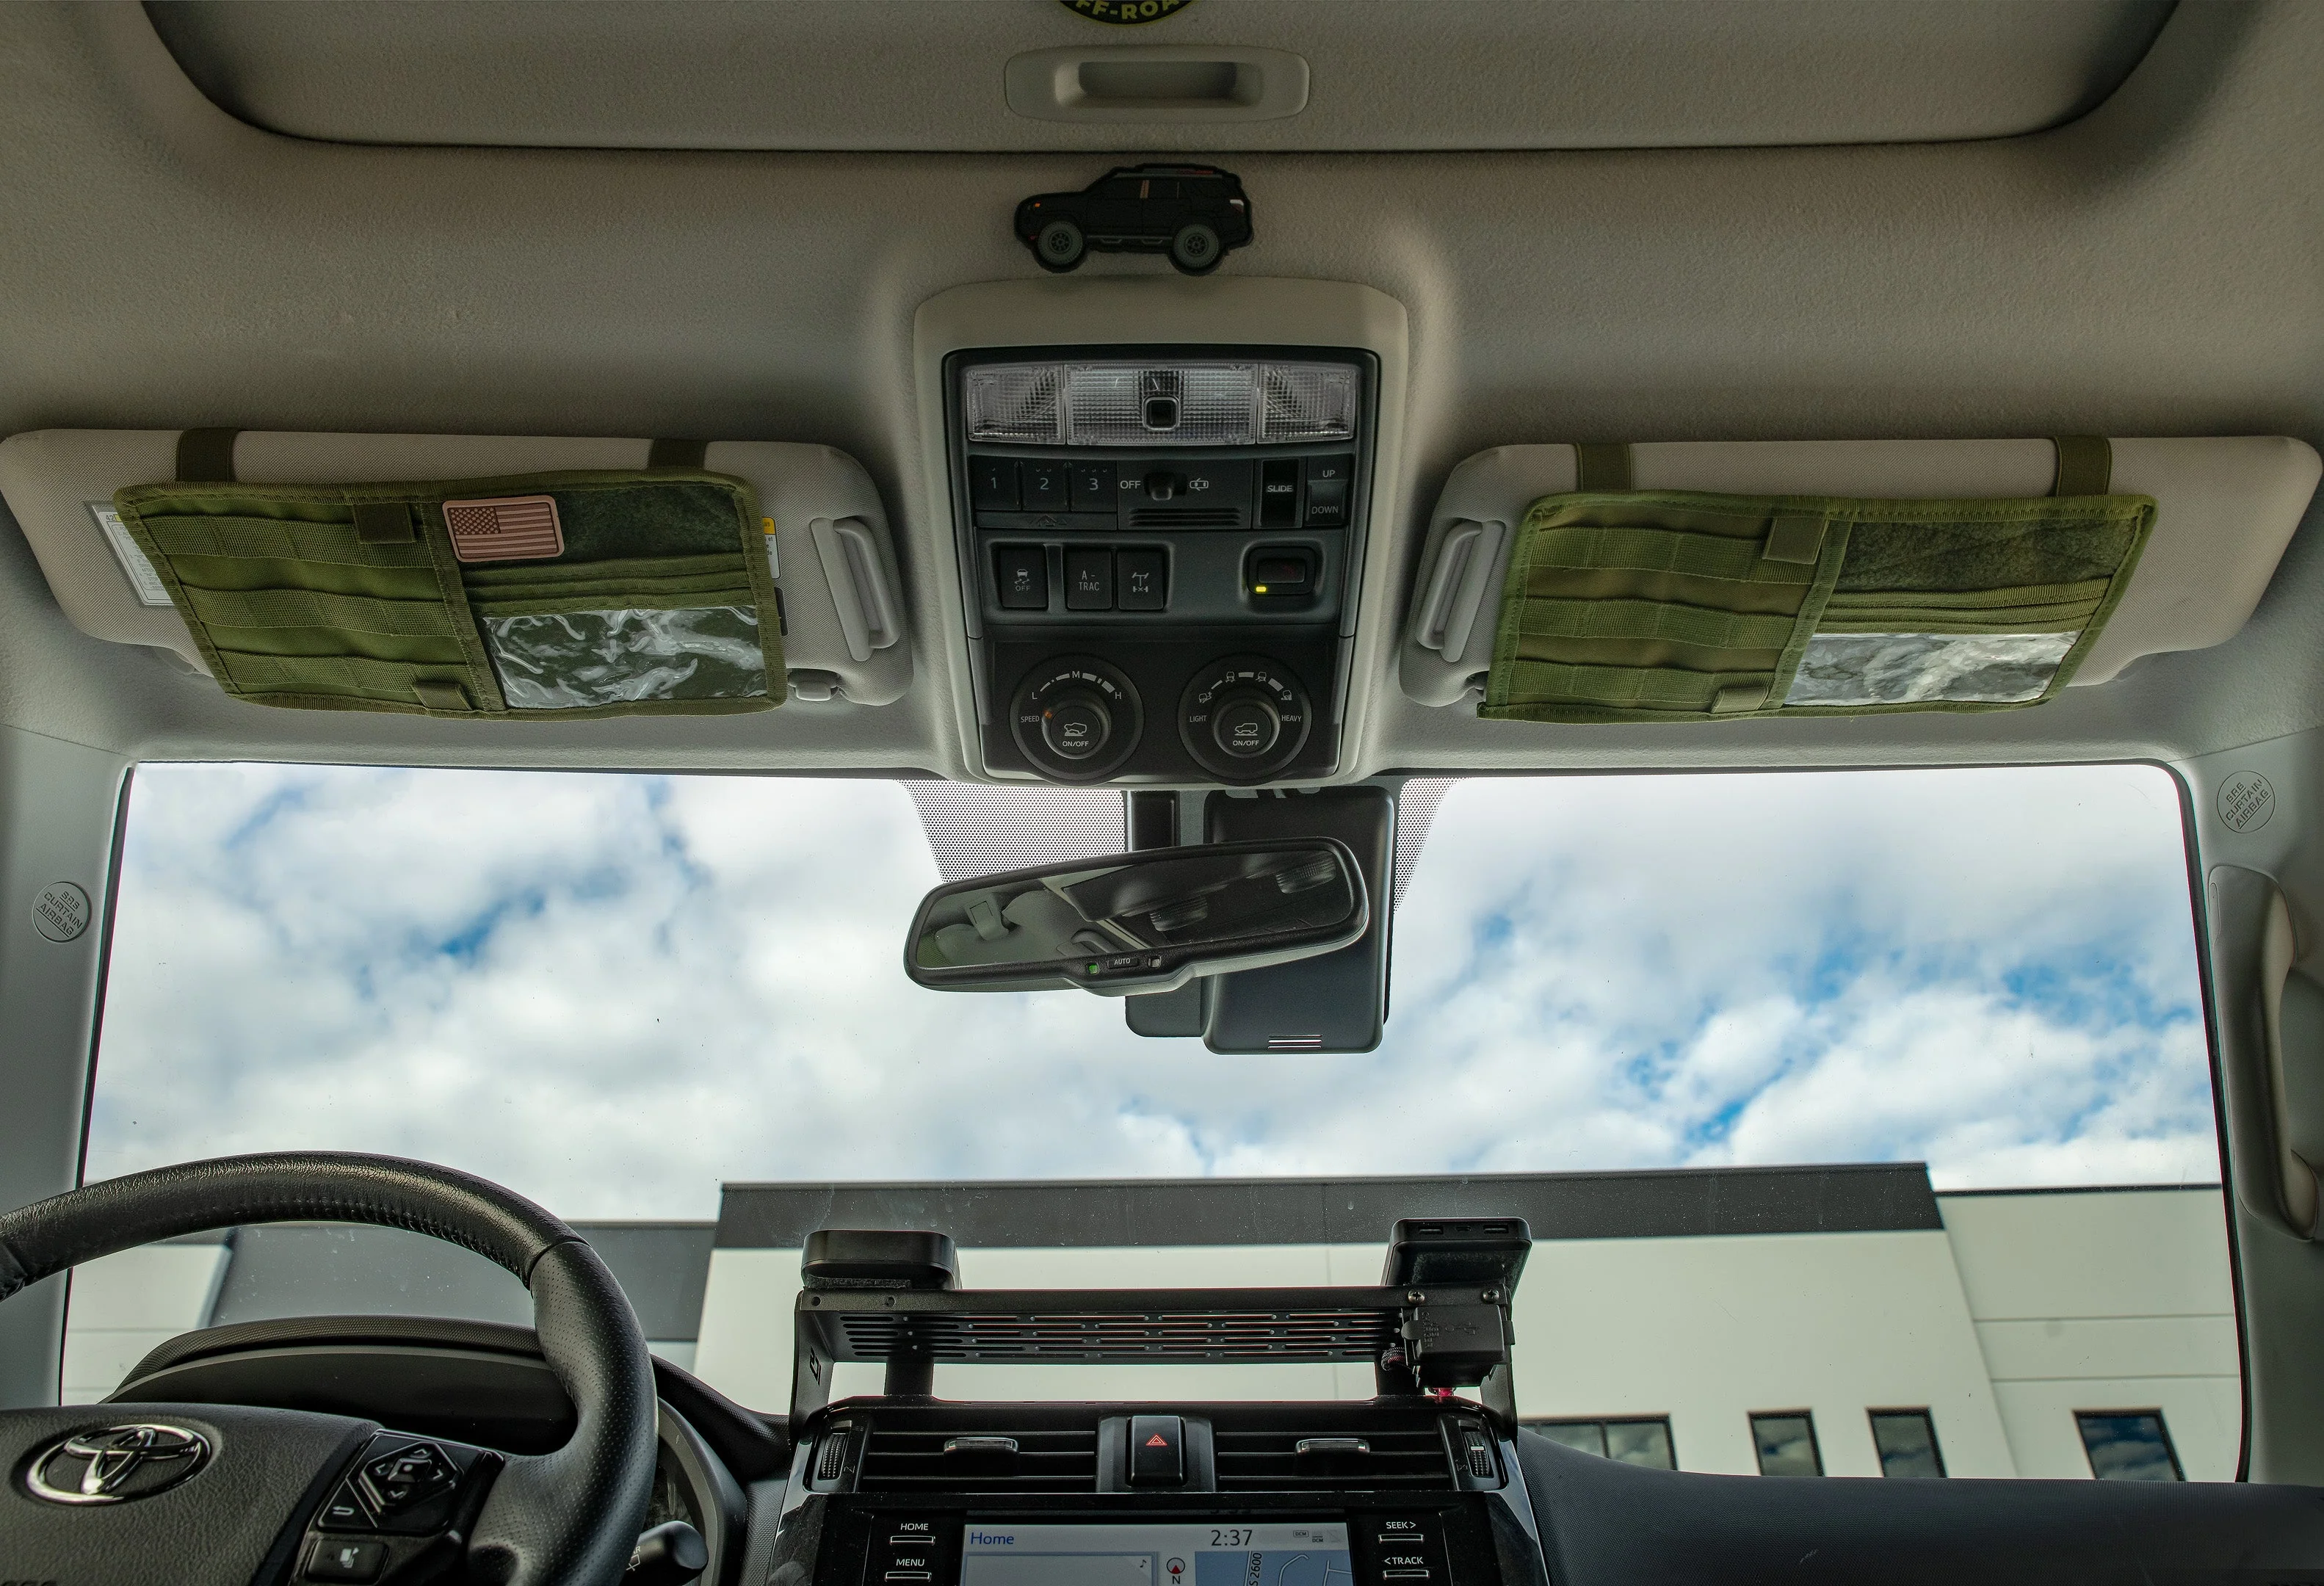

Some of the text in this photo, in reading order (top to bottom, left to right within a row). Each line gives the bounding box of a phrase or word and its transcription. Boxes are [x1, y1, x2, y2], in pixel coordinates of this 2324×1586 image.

[1322, 470, 1336, 478] UP
[991, 477, 996, 489] 1
[1040, 477, 1049, 490] 2
[1089, 478, 1098, 490] 3
[1120, 479, 1141, 489] OFF
[1267, 485, 1293, 493] SLIDE
[1311, 506, 1339, 514] DOWN
[1079, 582, 1100, 591] TRAC
[1072, 670, 1080, 678] M
[1032, 692, 1038, 700] L
[1115, 692, 1122, 700] H
[1021, 715, 1040, 723] SPEED
[1190, 714, 1207, 723] LIGHT
[1281, 714, 1302, 723] HEAVY
[2226, 778, 2263, 821] CURTAIN
[2235, 789, 2269, 828] AIRBAG
[61, 891, 80, 910] SRS
[44, 891, 83, 929] CURTAIN
[38, 903, 74, 935] AIRBAG
[1114, 957, 1131, 966] AUTO
[900, 1522, 929, 1531] HOME
[970, 1532, 1014, 1545] Home
[1211, 1529, 1253, 1546] 2:37
[896, 1557, 924, 1567] MENU
[1250, 1552, 1262, 1579] 2600
[1172, 1575, 1181, 1585] N
